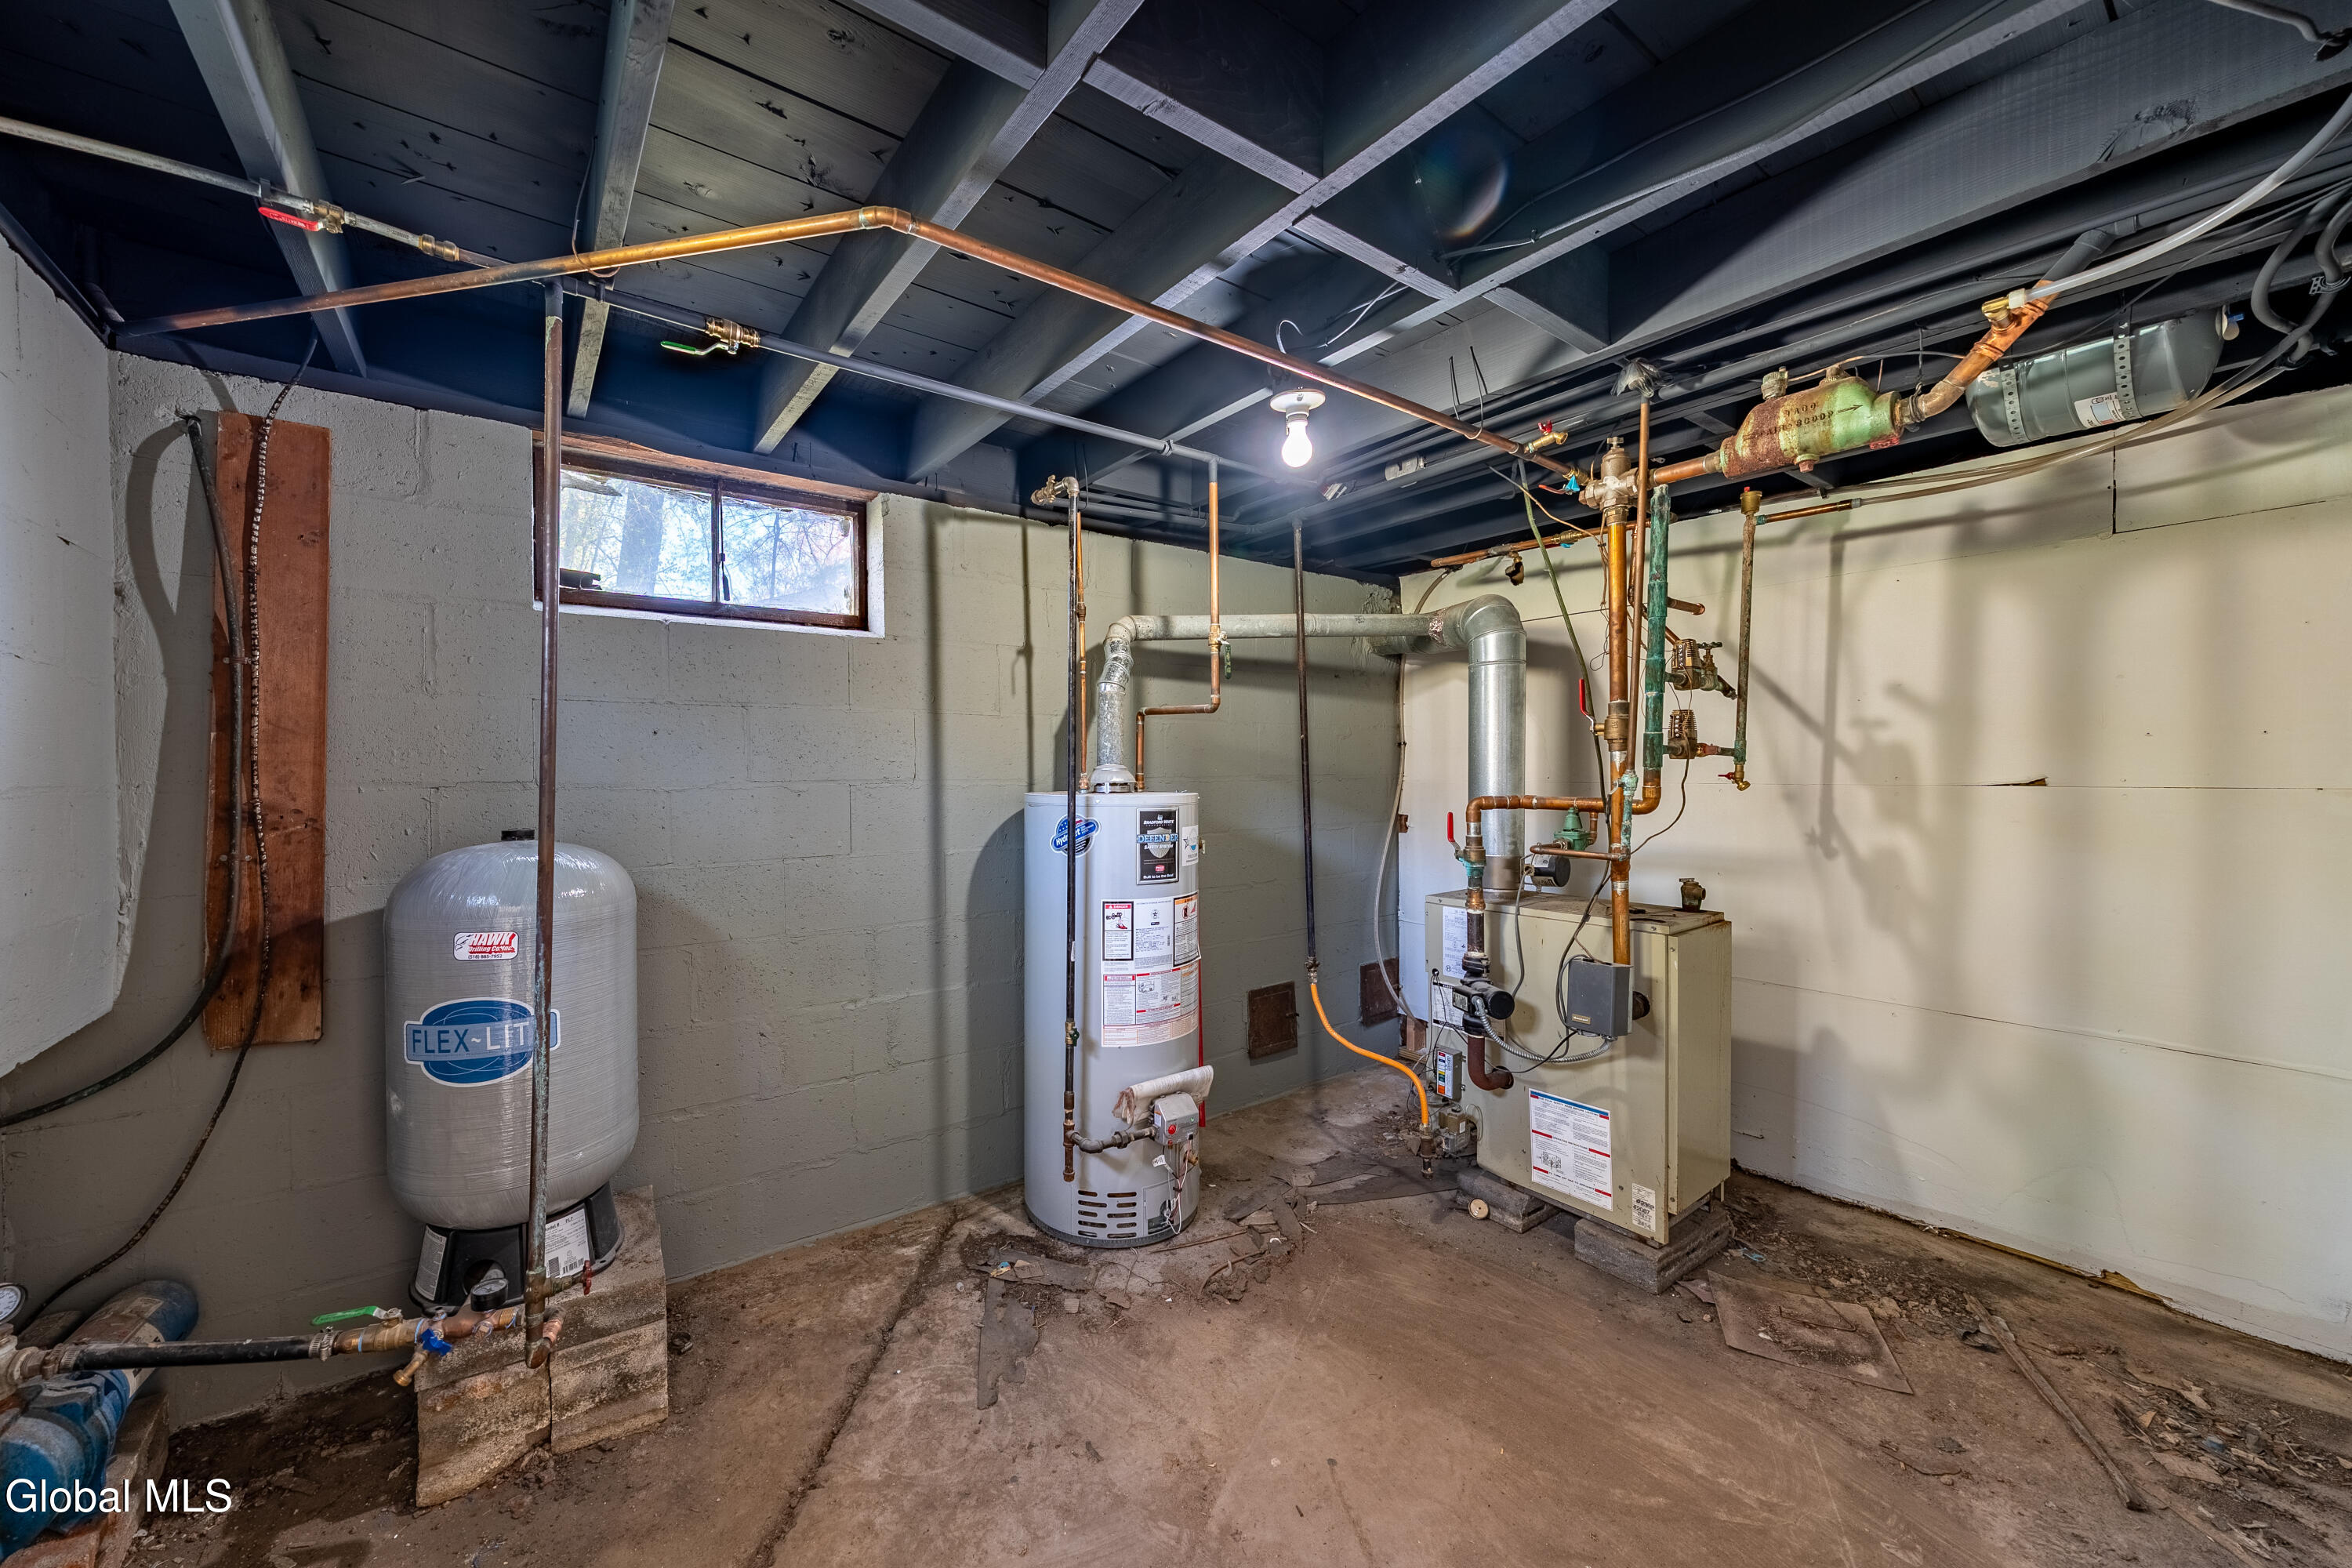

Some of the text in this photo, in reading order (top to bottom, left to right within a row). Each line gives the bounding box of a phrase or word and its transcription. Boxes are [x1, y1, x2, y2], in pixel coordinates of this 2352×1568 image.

[1784, 402, 1817, 417] TACO
[1795, 410, 1834, 427] SCOOP
[1137, 833, 1178, 843] DEFENDER
[470, 933, 512, 946] HAWK
